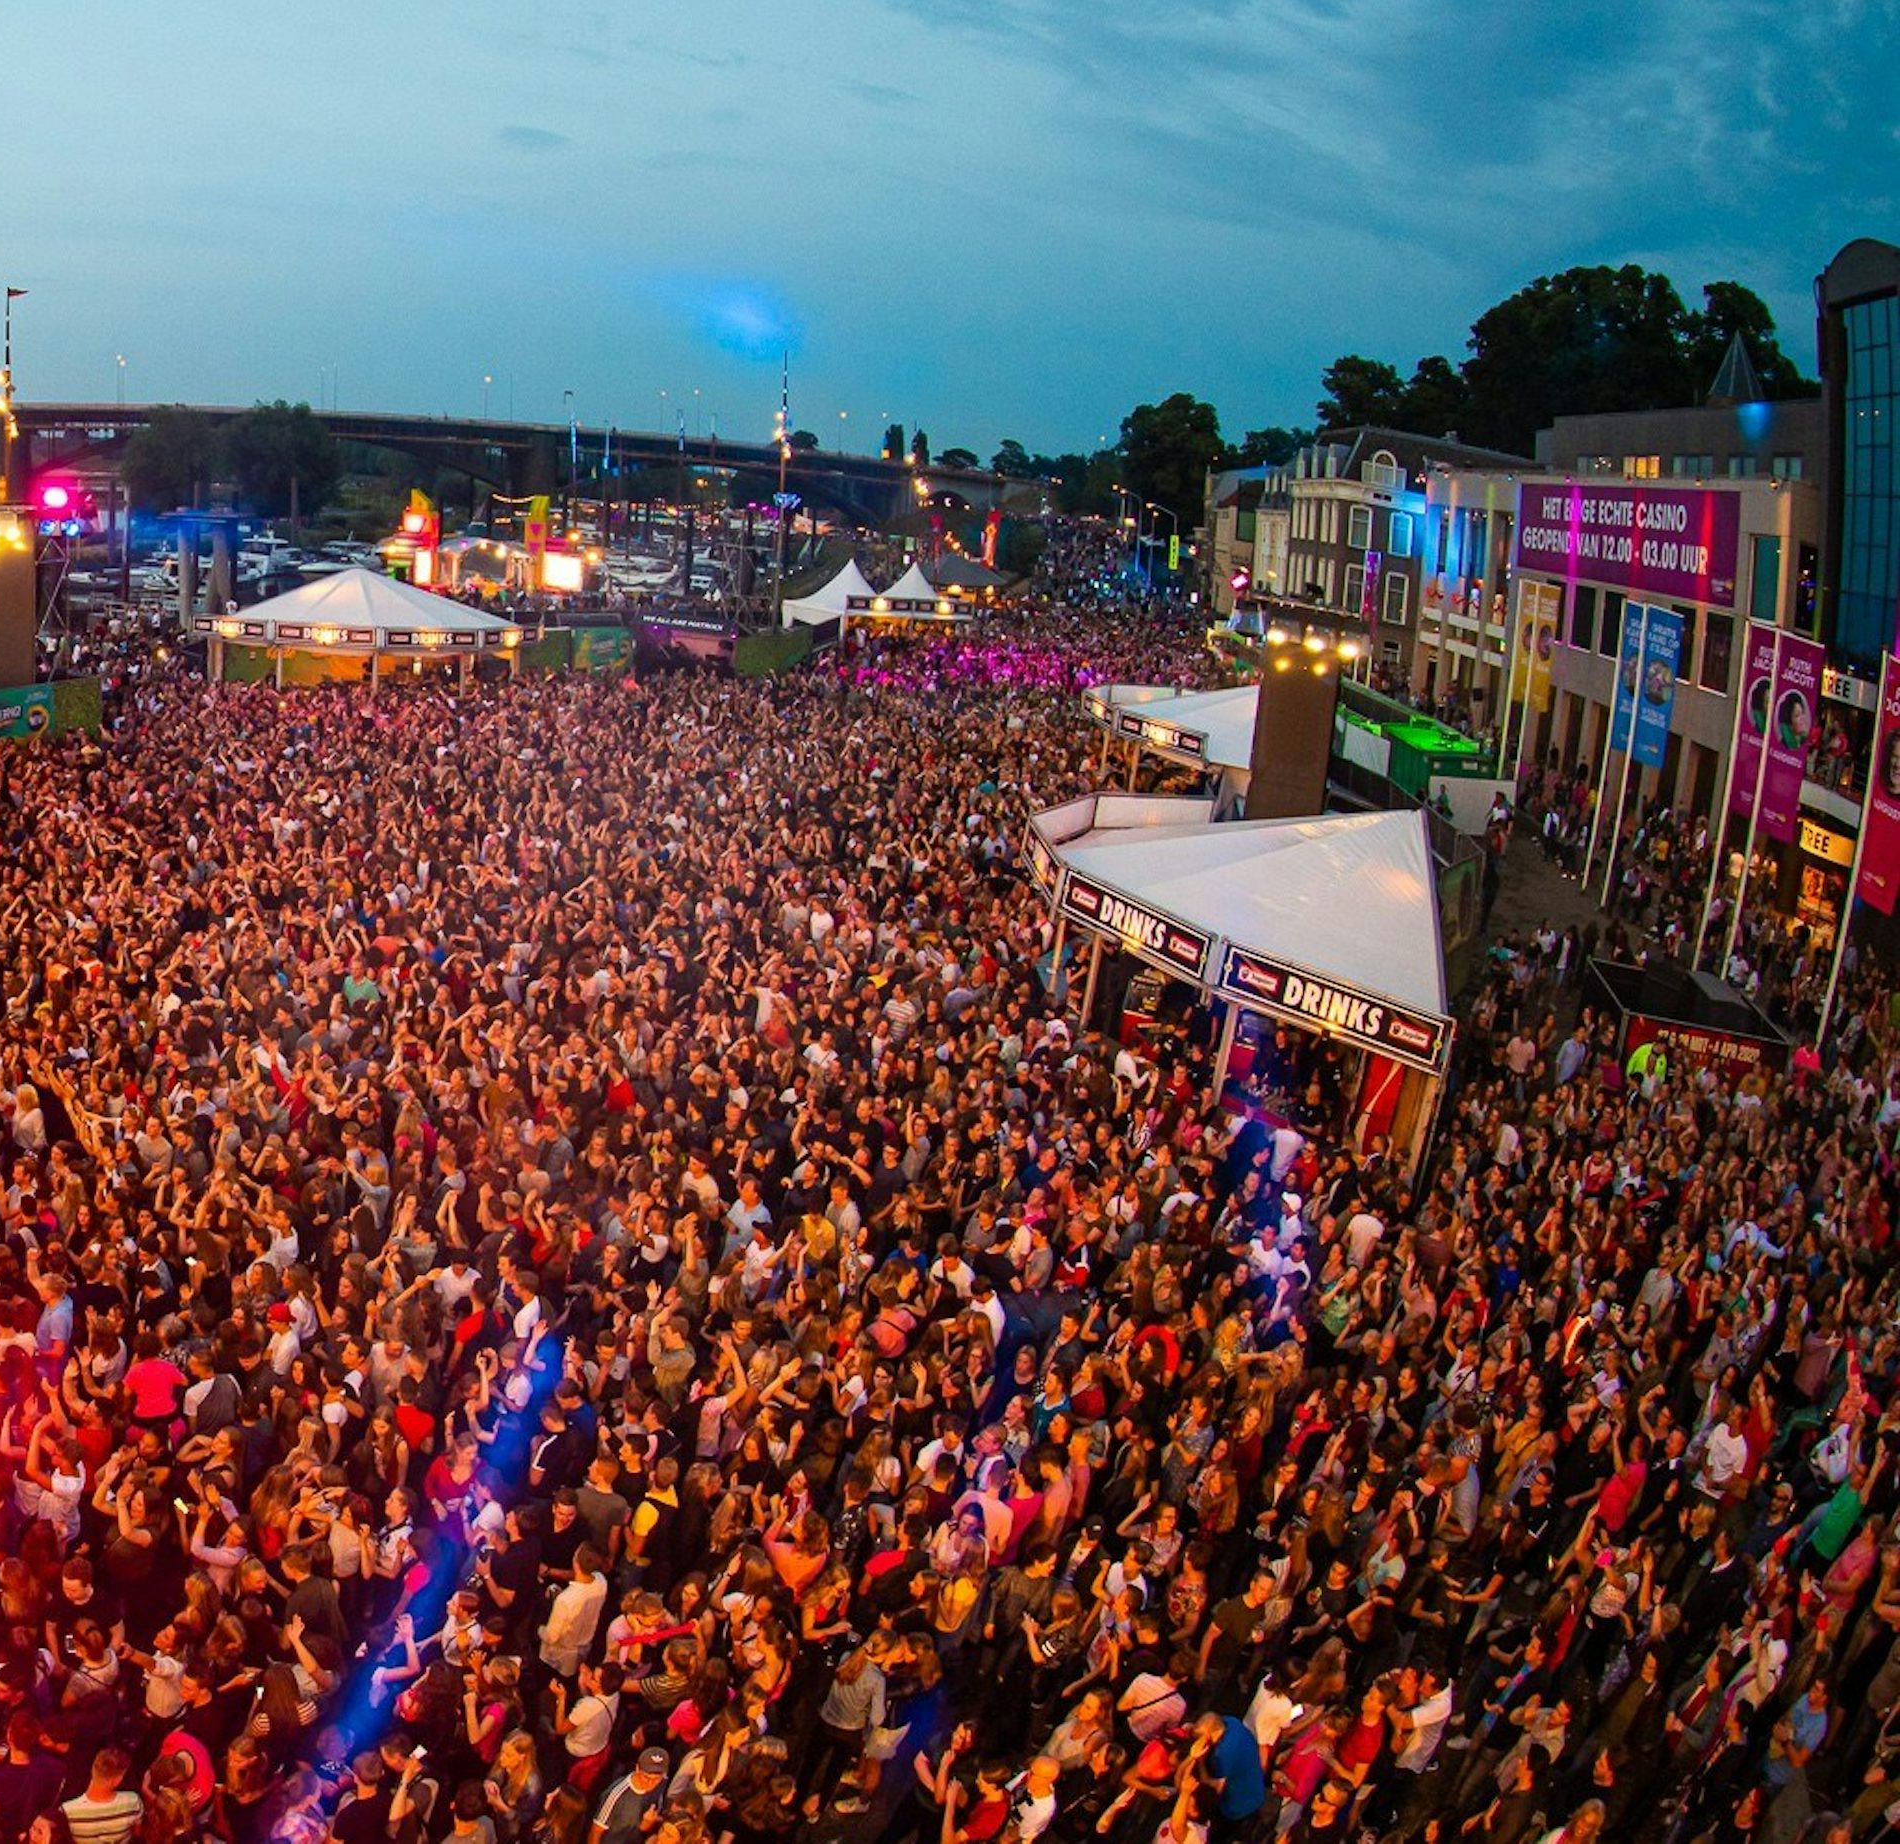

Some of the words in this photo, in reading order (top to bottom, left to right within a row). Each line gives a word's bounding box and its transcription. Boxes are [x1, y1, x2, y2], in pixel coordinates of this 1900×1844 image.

[1542, 496, 1563, 520] HET
[1563, 498, 1596, 524] EGE
[1598, 500, 1634, 527] ECHTE
[1635, 502, 1688, 532] CASINO
[1522, 526, 1573, 554] GEOPEND
[1576, 532, 1598, 559] VAN
[1602, 534, 1633, 564] 12.00
[1642, 540, 1677, 569] 03.00
[1680, 545, 1709, 576] UUR
[411, 632, 453, 645] DRINKS
[1099, 893, 1167, 950] DRINKS
[1283, 976, 1384, 1036] DRINKS
